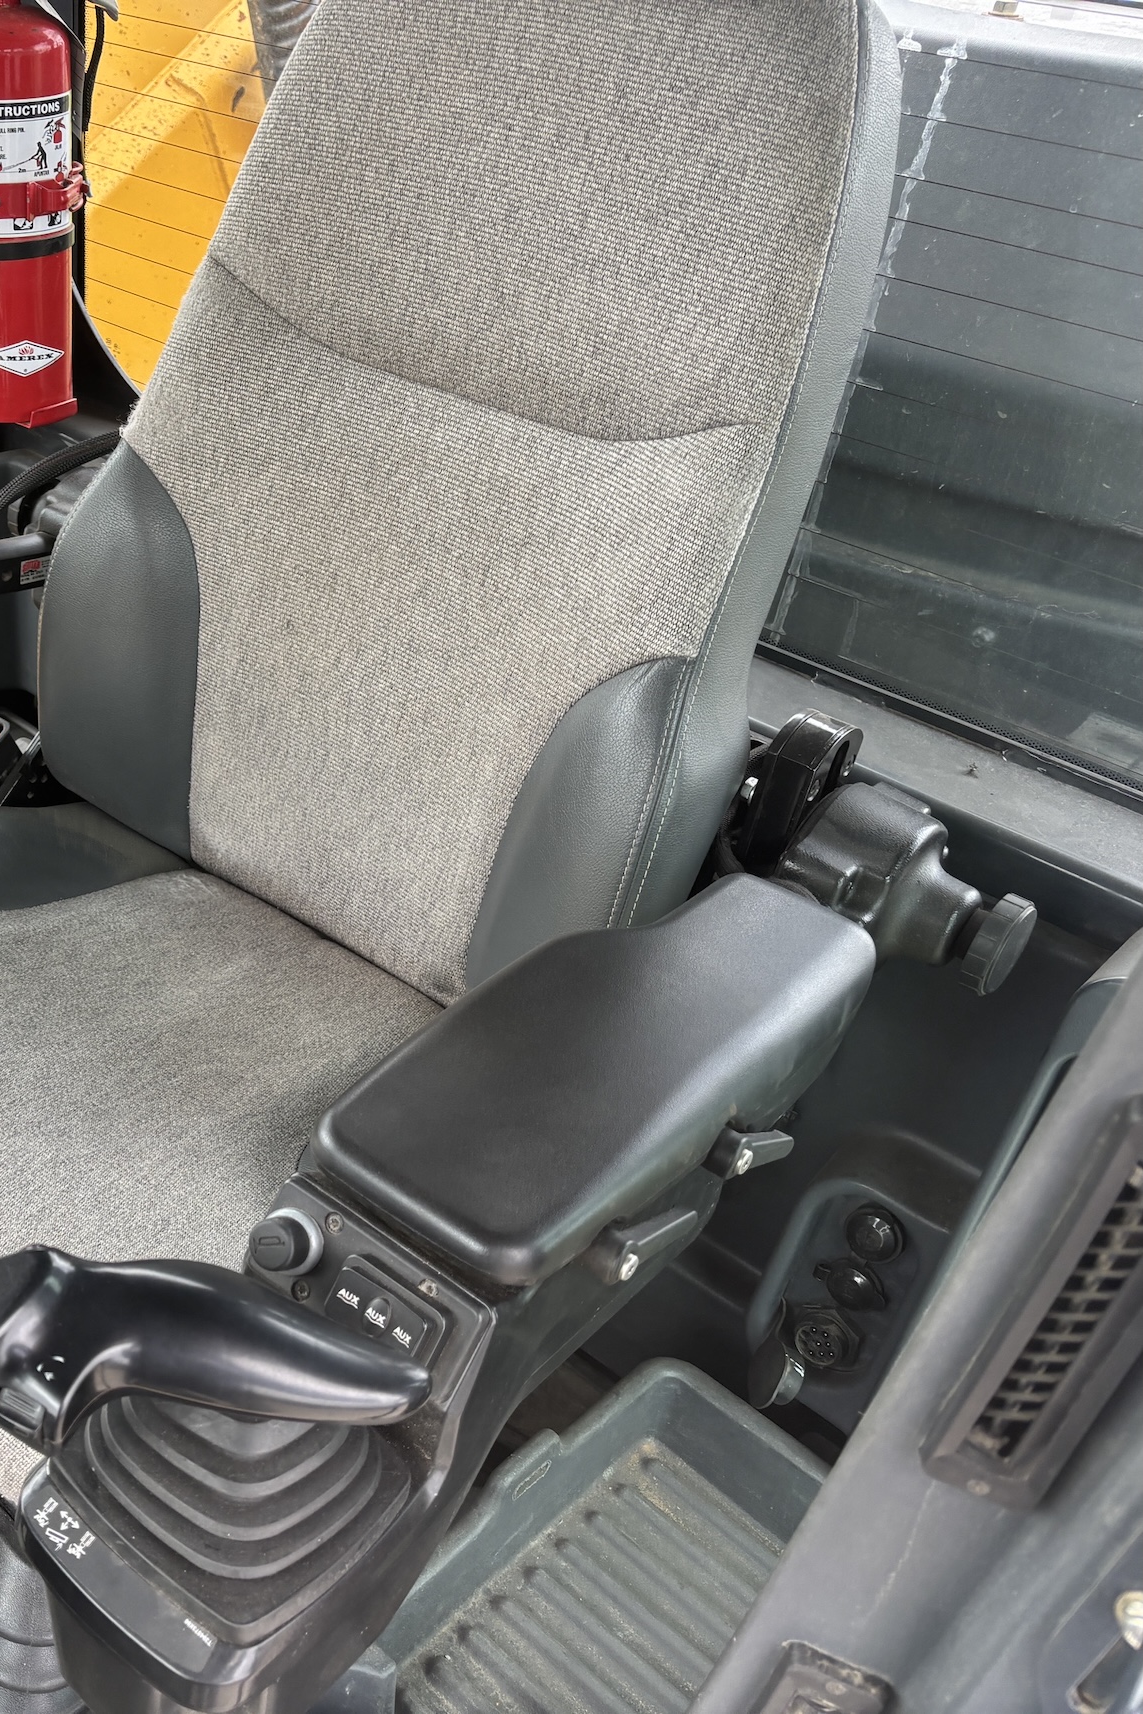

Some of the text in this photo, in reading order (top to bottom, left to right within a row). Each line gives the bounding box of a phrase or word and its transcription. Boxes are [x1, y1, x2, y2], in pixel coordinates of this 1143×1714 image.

[338, 1287, 360, 1305] AUX
[365, 1307, 387, 1325] AUX
[393, 1326, 412, 1344] AUX
